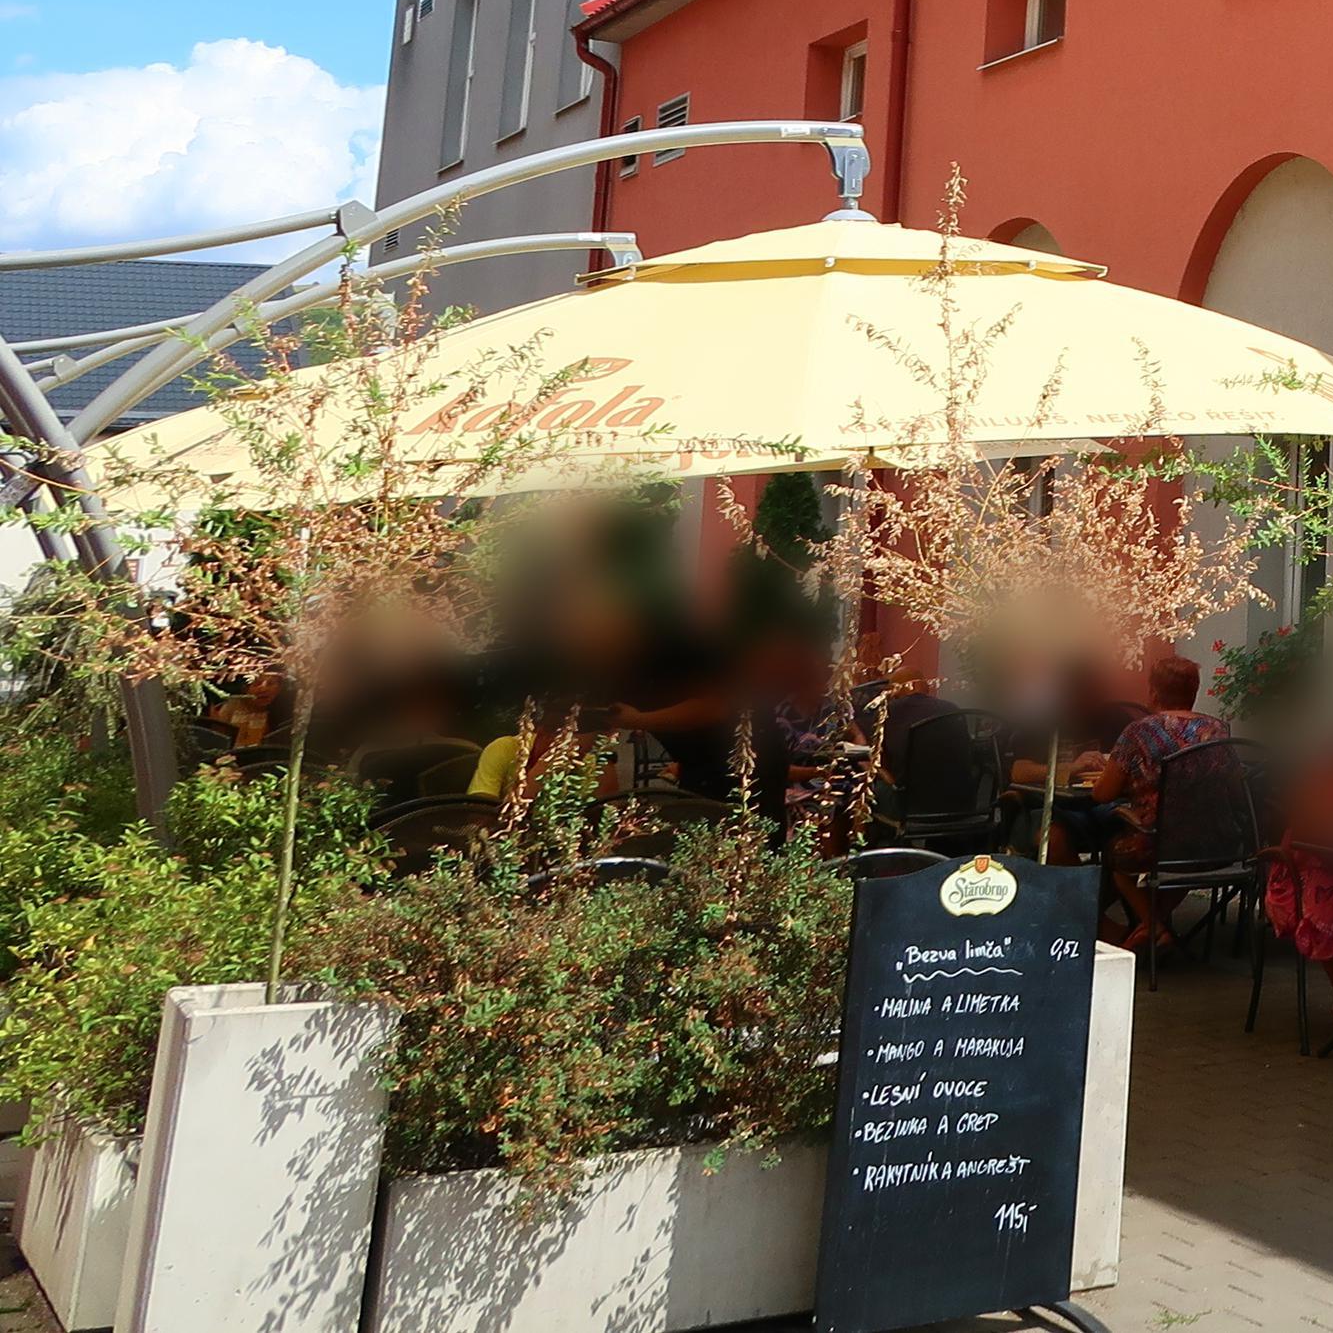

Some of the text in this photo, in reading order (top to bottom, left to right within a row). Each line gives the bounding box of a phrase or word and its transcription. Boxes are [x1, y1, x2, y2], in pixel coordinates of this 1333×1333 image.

[948, 877, 1009, 908] Starobrno
[881, 994, 1020, 1018] MALINA A LIMETKA
[876, 1037, 1024, 1063] MANGO A MARAKUJA
[870, 1072, 988, 1106] LESNÍ OVOCE
[863, 1117, 927, 1143] BEZINKA
[937, 1115, 948, 1135] A
[863, 1151, 1031, 1192] RAKYTNÍK A ANGREŠT
